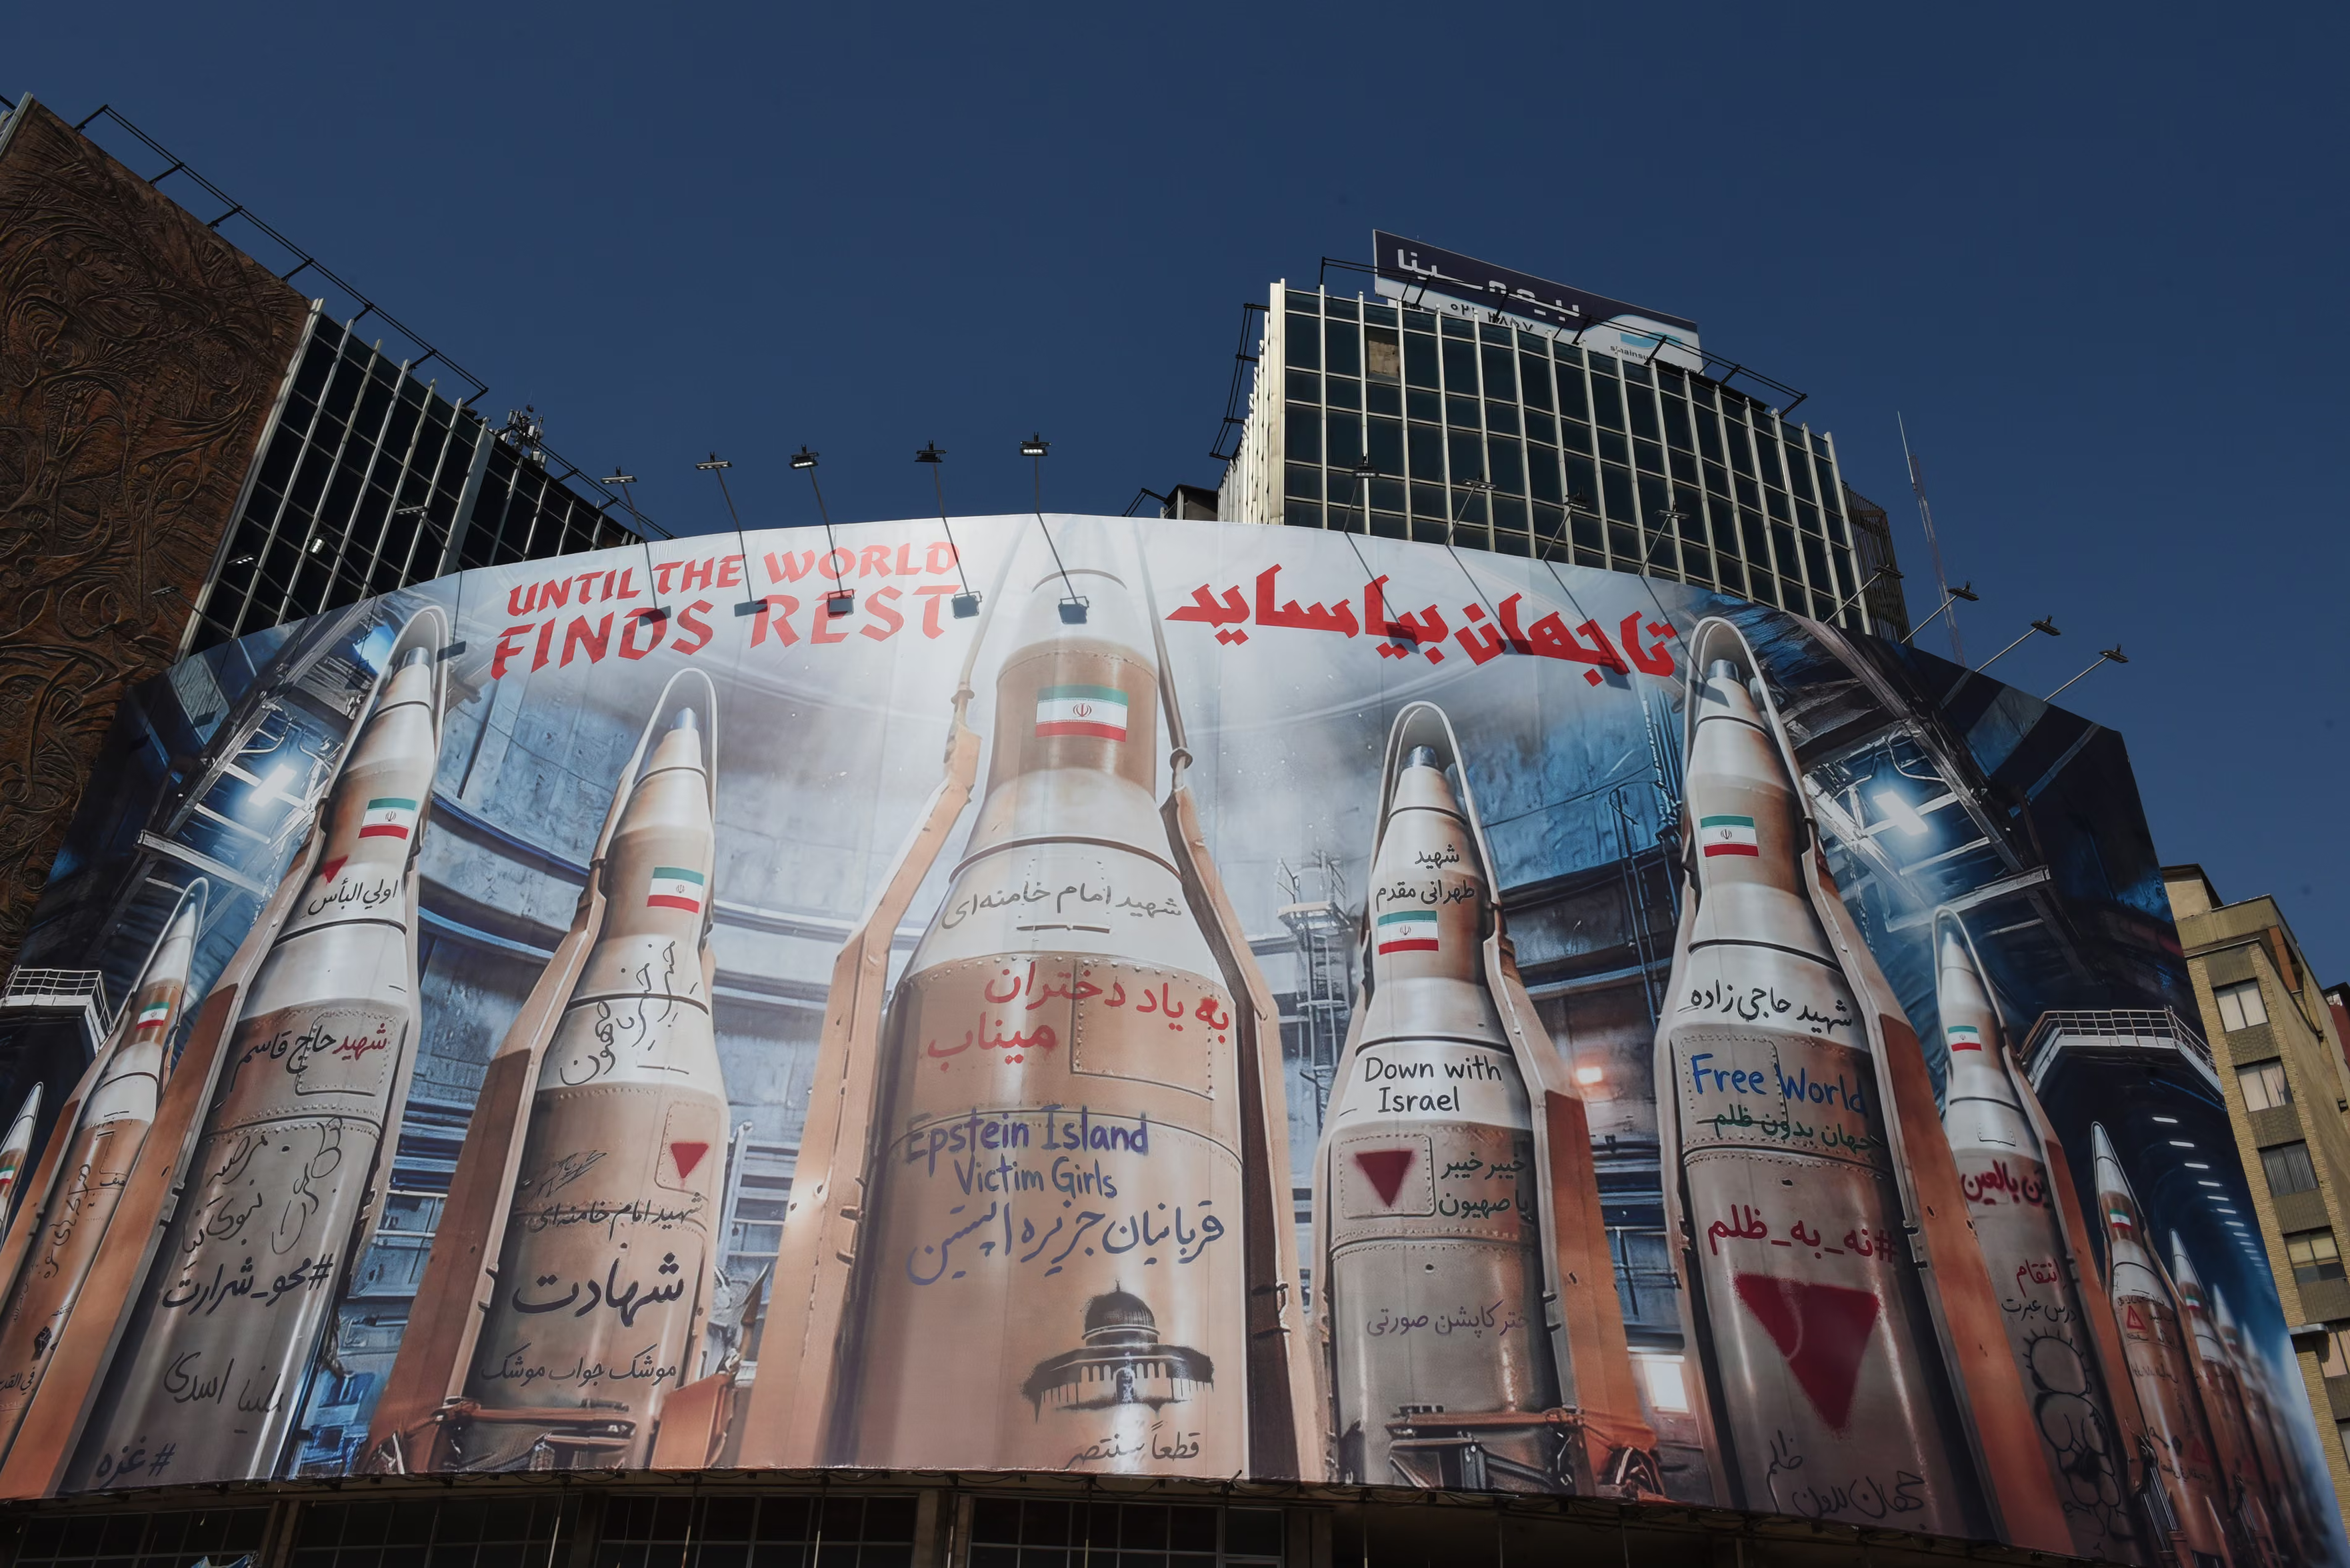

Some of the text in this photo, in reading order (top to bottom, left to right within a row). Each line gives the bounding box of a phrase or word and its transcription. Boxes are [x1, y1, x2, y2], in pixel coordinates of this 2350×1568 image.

[507, 541, 960, 617] UNTIL THE WORLD
[490, 583, 962, 681] FINDS REST
[1454, 592, 1631, 687] جهان
[1620, 610, 1677, 678] تا
[1414, 843, 1460, 869] شهید
[1056, 882, 1112, 913] امام
[1115, 897, 1183, 918] شهید
[1375, 879, 1475, 911] طهرانی مقدم
[984, 961, 1230, 1044] به یاد دختران
[1796, 999, 1853, 1035] شهید
[229, 1023, 389, 1093] شهید حاج قاسم
[928, 1011, 1057, 1073] میناب
[1365, 1055, 1503, 1083] Down with
[1691, 1053, 1869, 1118] Free World
[1377, 1085, 1460, 1113] Israel
[906, 1103, 1149, 1177] Epstein Island
[954, 1153, 1118, 1199] Victim Girls
[1440, 1151, 1527, 1181] خیبر خیبر
[609, 1199, 651, 1242] امام
[655, 1191, 704, 1230] شهید
[1438, 1193, 1511, 1219] صهیون
[1020, 1199, 1106, 1277] جزیره
[1102, 1199, 1225, 1265] قربانیان
[511, 1251, 685, 1328] شهادت
[2015, 1257, 2063, 1299] انتقام
[1366, 1298, 1529, 1339] ختر کاپشن صورتی
[480, 1342, 677, 1387] موشک جواب موشک
